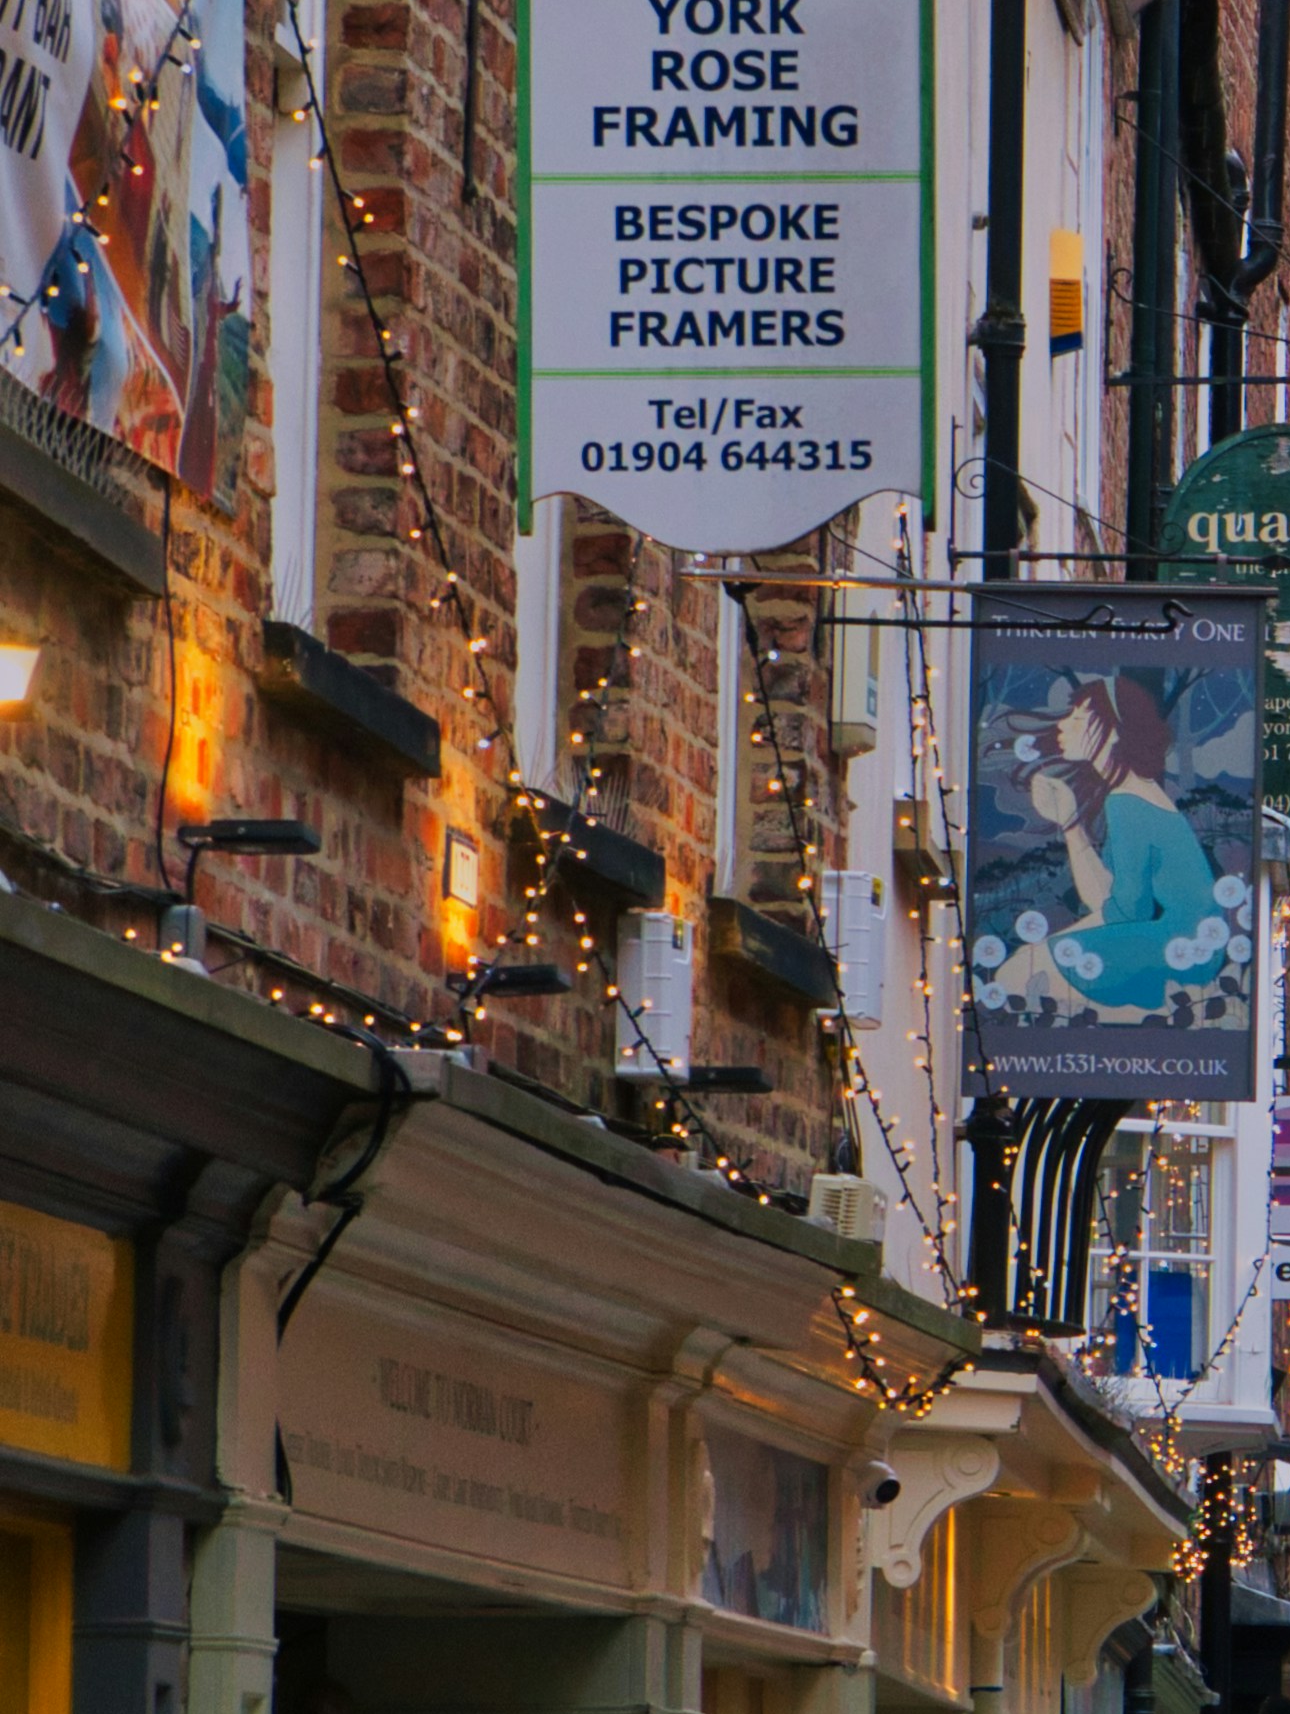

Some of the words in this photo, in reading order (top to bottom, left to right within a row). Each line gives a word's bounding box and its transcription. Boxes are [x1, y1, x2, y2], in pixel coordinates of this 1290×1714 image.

[652, 49, 800, 92] ROSE
[593, 104, 859, 149] FRAMING
[614, 203, 840, 242] BESPOKE
[619, 256, 836, 295] PICTURE
[610, 309, 846, 347] FRAMERS
[648, 397, 804, 435] Tel/Fax
[581, 440, 707, 472] 01904
[720, 440, 873, 472] 644315
[1192, 618, 1245, 642] ONE
[1263, 794, 1290, 814] 04)
[993, 1052, 1229, 1076] WWW.1331-YORK.CO.UK
